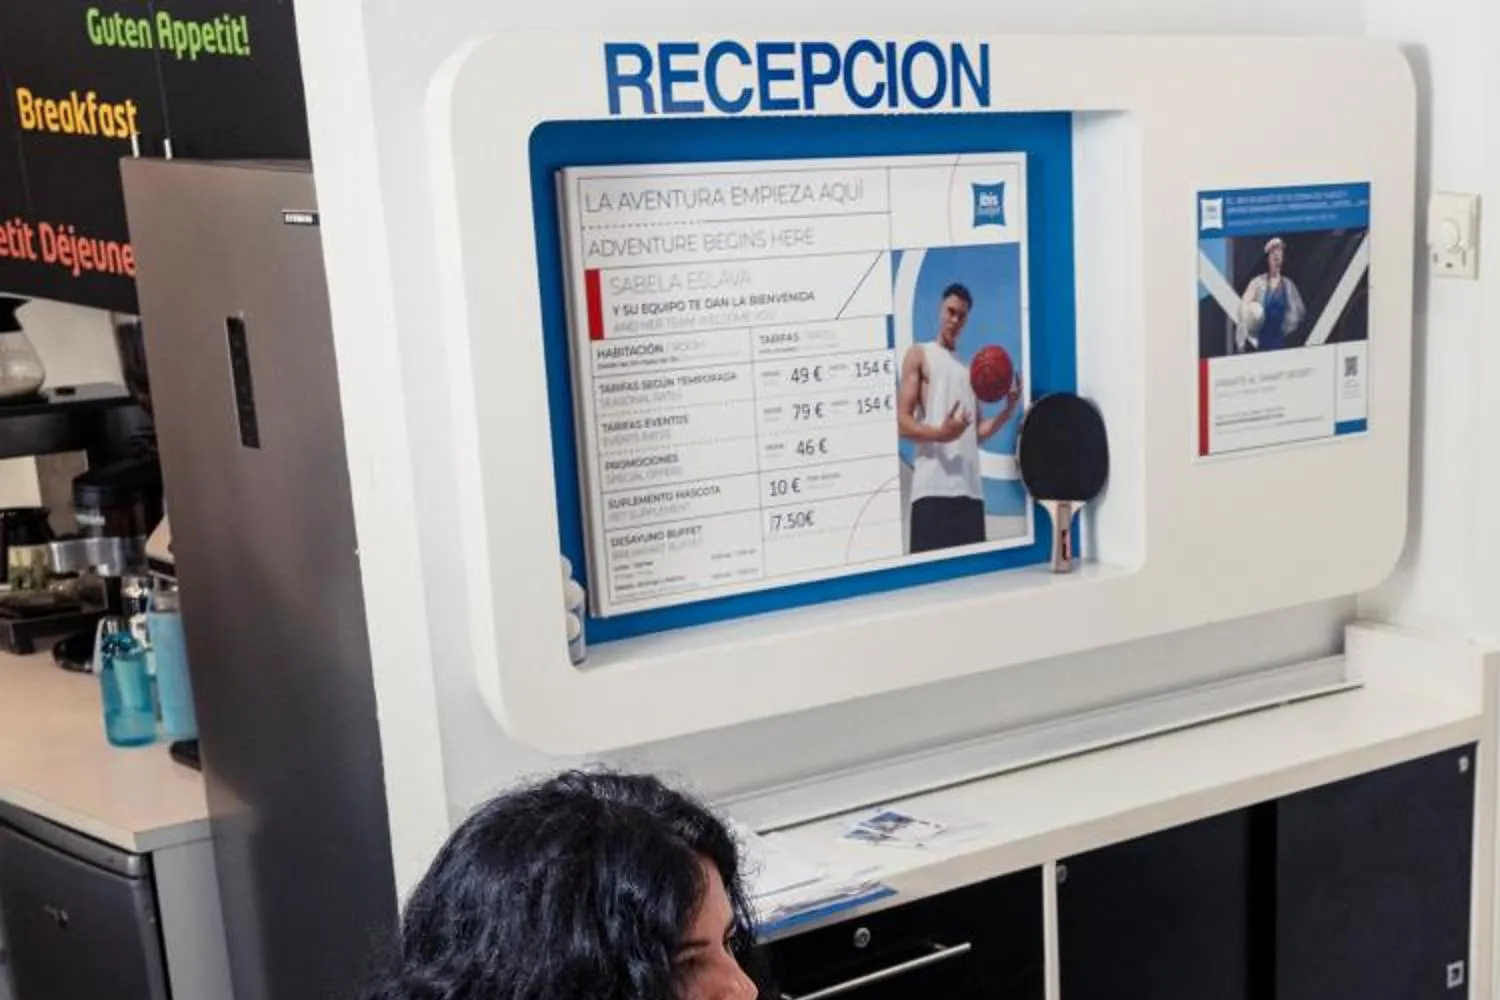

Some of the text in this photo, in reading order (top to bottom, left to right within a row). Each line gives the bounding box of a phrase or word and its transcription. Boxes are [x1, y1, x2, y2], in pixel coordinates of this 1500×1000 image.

[87, 8, 250, 60] Guten Appetit!
[604, 39, 990, 114] RECEPCION
[16, 87, 138, 138] Breakfast
[585, 178, 864, 213] LA AVENTURA EMPIEZA AQUÍ
[0, 217, 136, 277] etit Déjeune
[588, 228, 816, 257] ADVENTURE BEGINS HERE
[609, 270, 752, 296] SABELA ESLAVA
[612, 290, 816, 317] Y SU EQUIPO TE DAN LA BIENVENIDA
[597, 343, 664, 358] HABITACIÓN
[759, 332, 799, 345] TARIFAS
[791, 367, 809, 383] 49
[813, 365, 823, 382] €
[855, 360, 880, 378] 154
[882, 359, 892, 375] €
[792, 403, 811, 420] 79
[815, 401, 824, 418] €
[857, 396, 881, 415] 154
[884, 394, 893, 411] €
[795, 439, 815, 456] 46
[818, 437, 828, 454] €
[608, 485, 721, 510] SUPLEMENTO MASCOTA
[769, 479, 788, 497] 10
[791, 477, 800, 493] €
